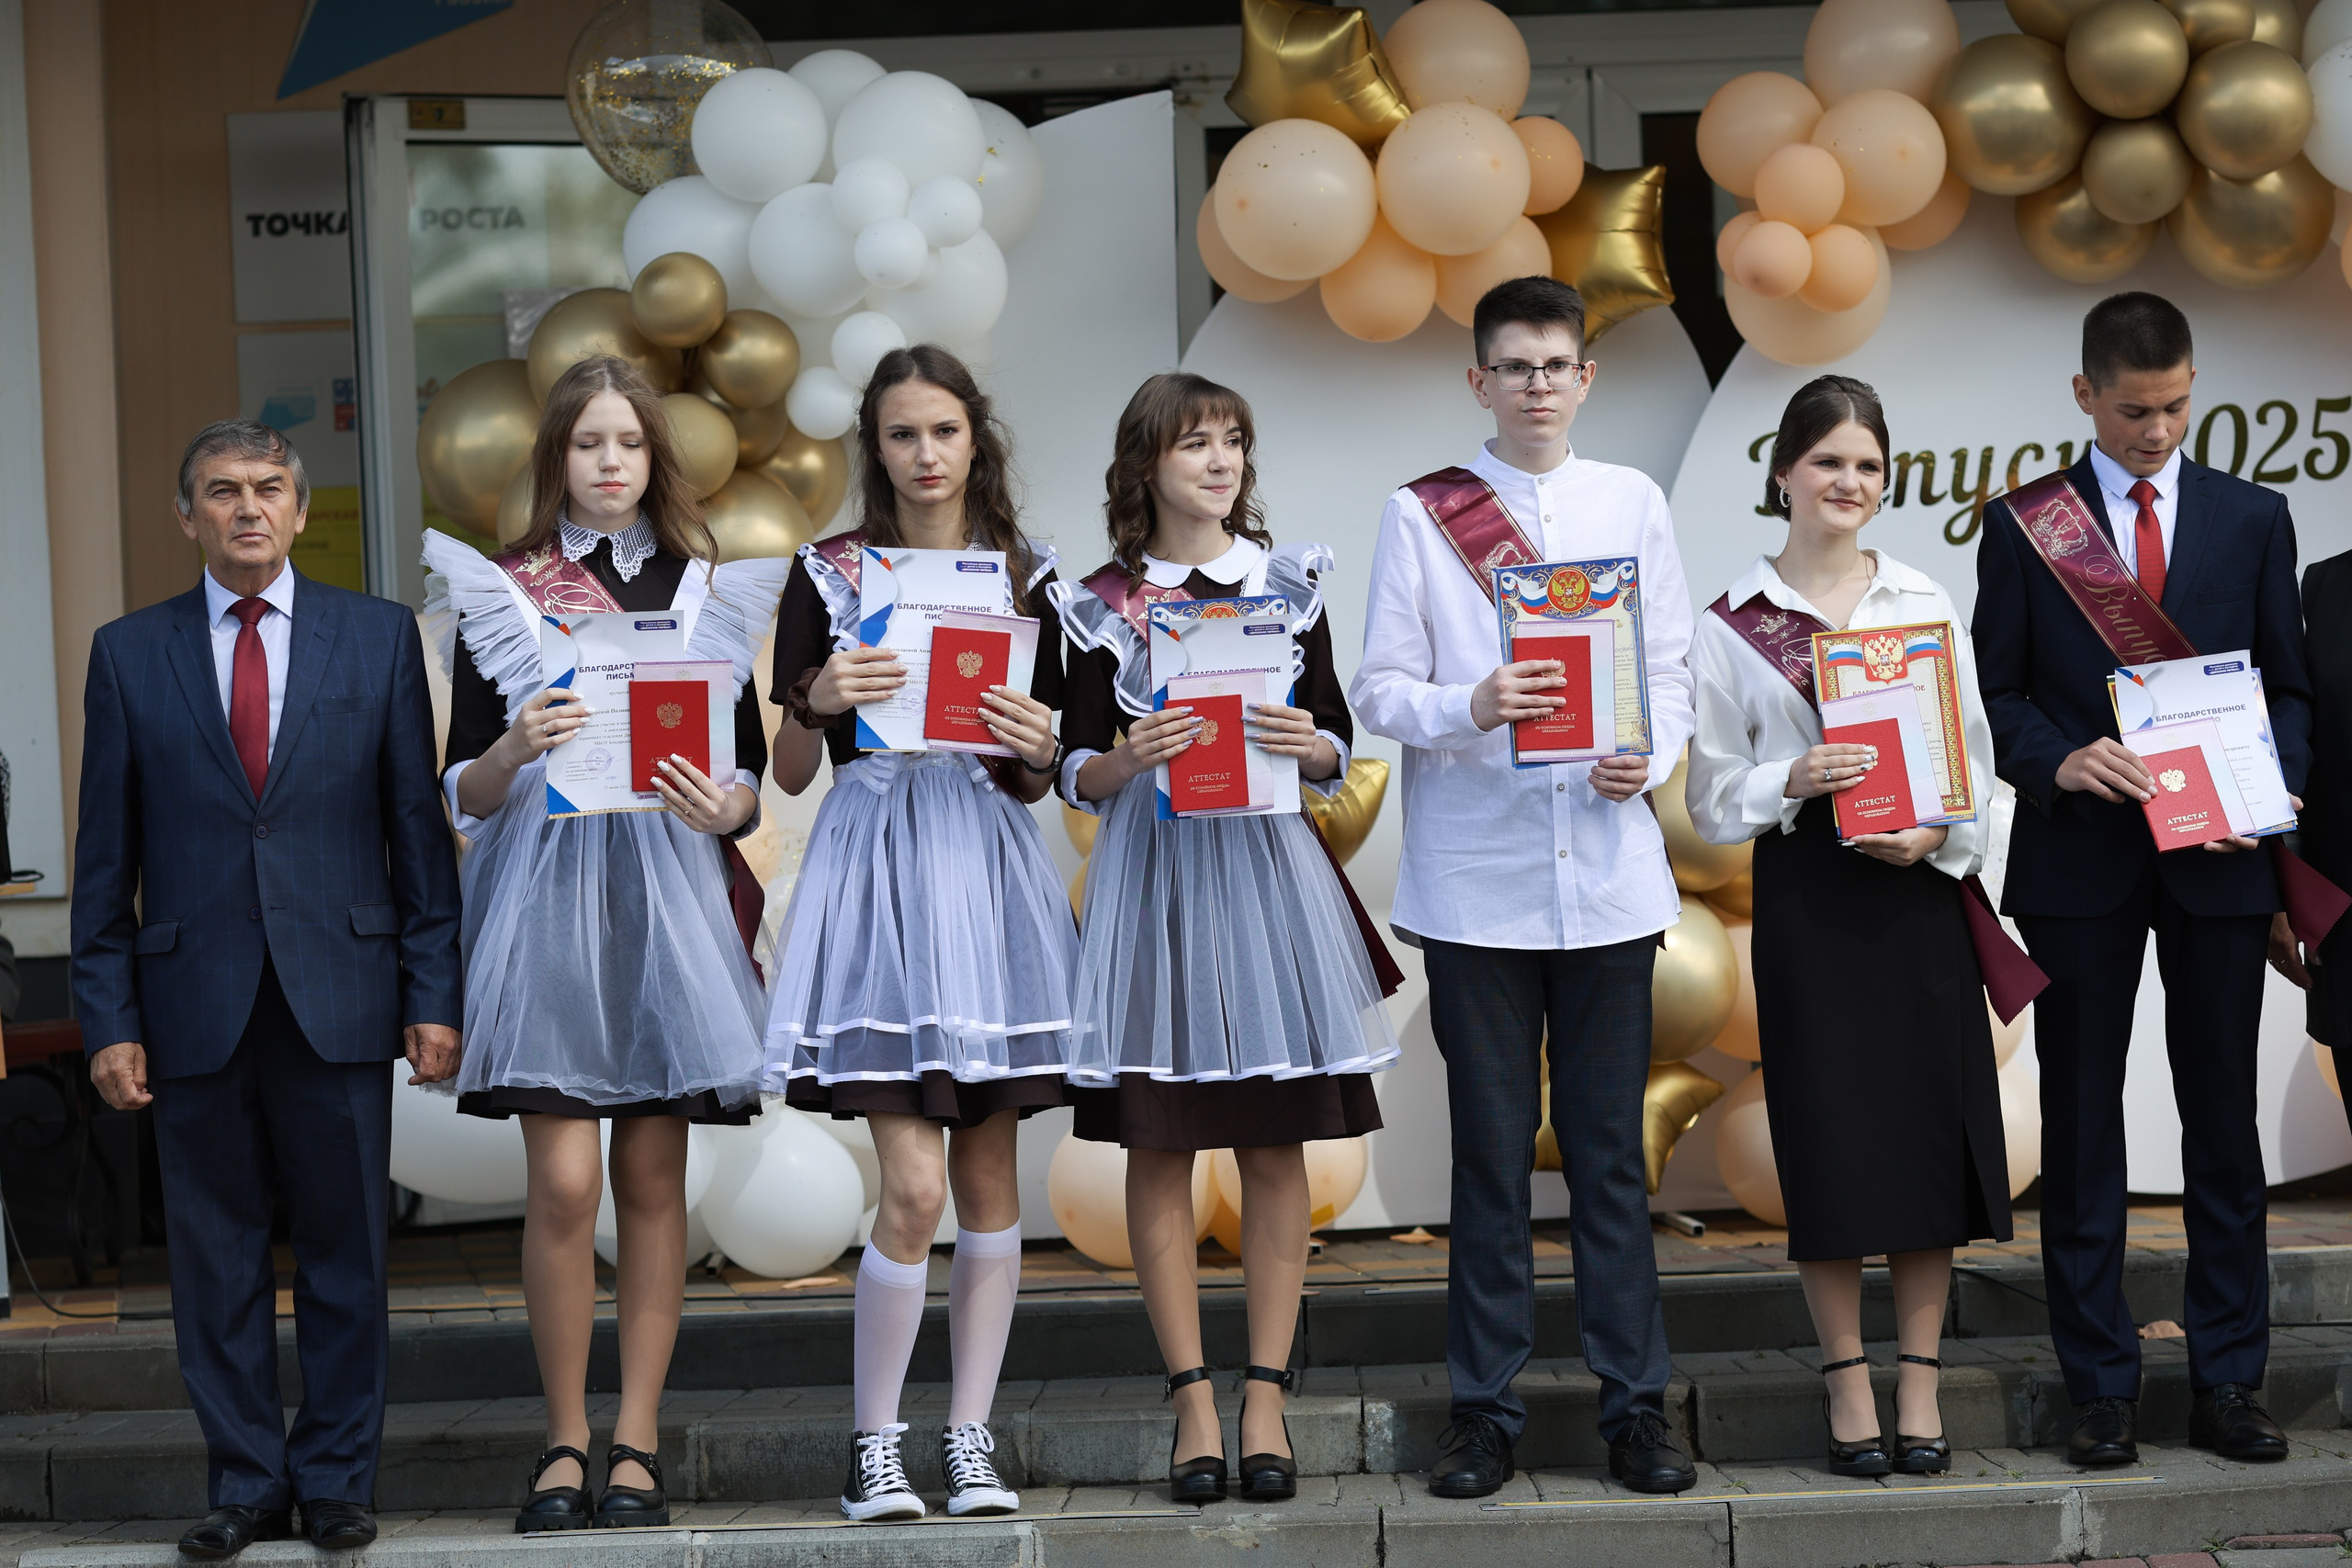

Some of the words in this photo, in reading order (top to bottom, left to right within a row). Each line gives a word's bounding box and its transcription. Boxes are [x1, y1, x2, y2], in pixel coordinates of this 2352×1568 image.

[419, 207, 526, 232] РОСТА
[2180, 396, 2351, 484] 025
[924, 613, 943, 621] ПИС
[579, 662, 634, 673] БЛАГОДАРСТ
[606, 672, 634, 681] ПИСЬМ
[944, 705, 979, 715] АТТЕСТ
[2155, 704, 2246, 722] БЛАГОДАРСТВЕННОЕ
[1188, 772, 1231, 783] АТТЕСТАТ
[1854, 795, 1895, 808] АТТЕСТАТ
[2167, 811, 2208, 825] АТТЕСТАТ
